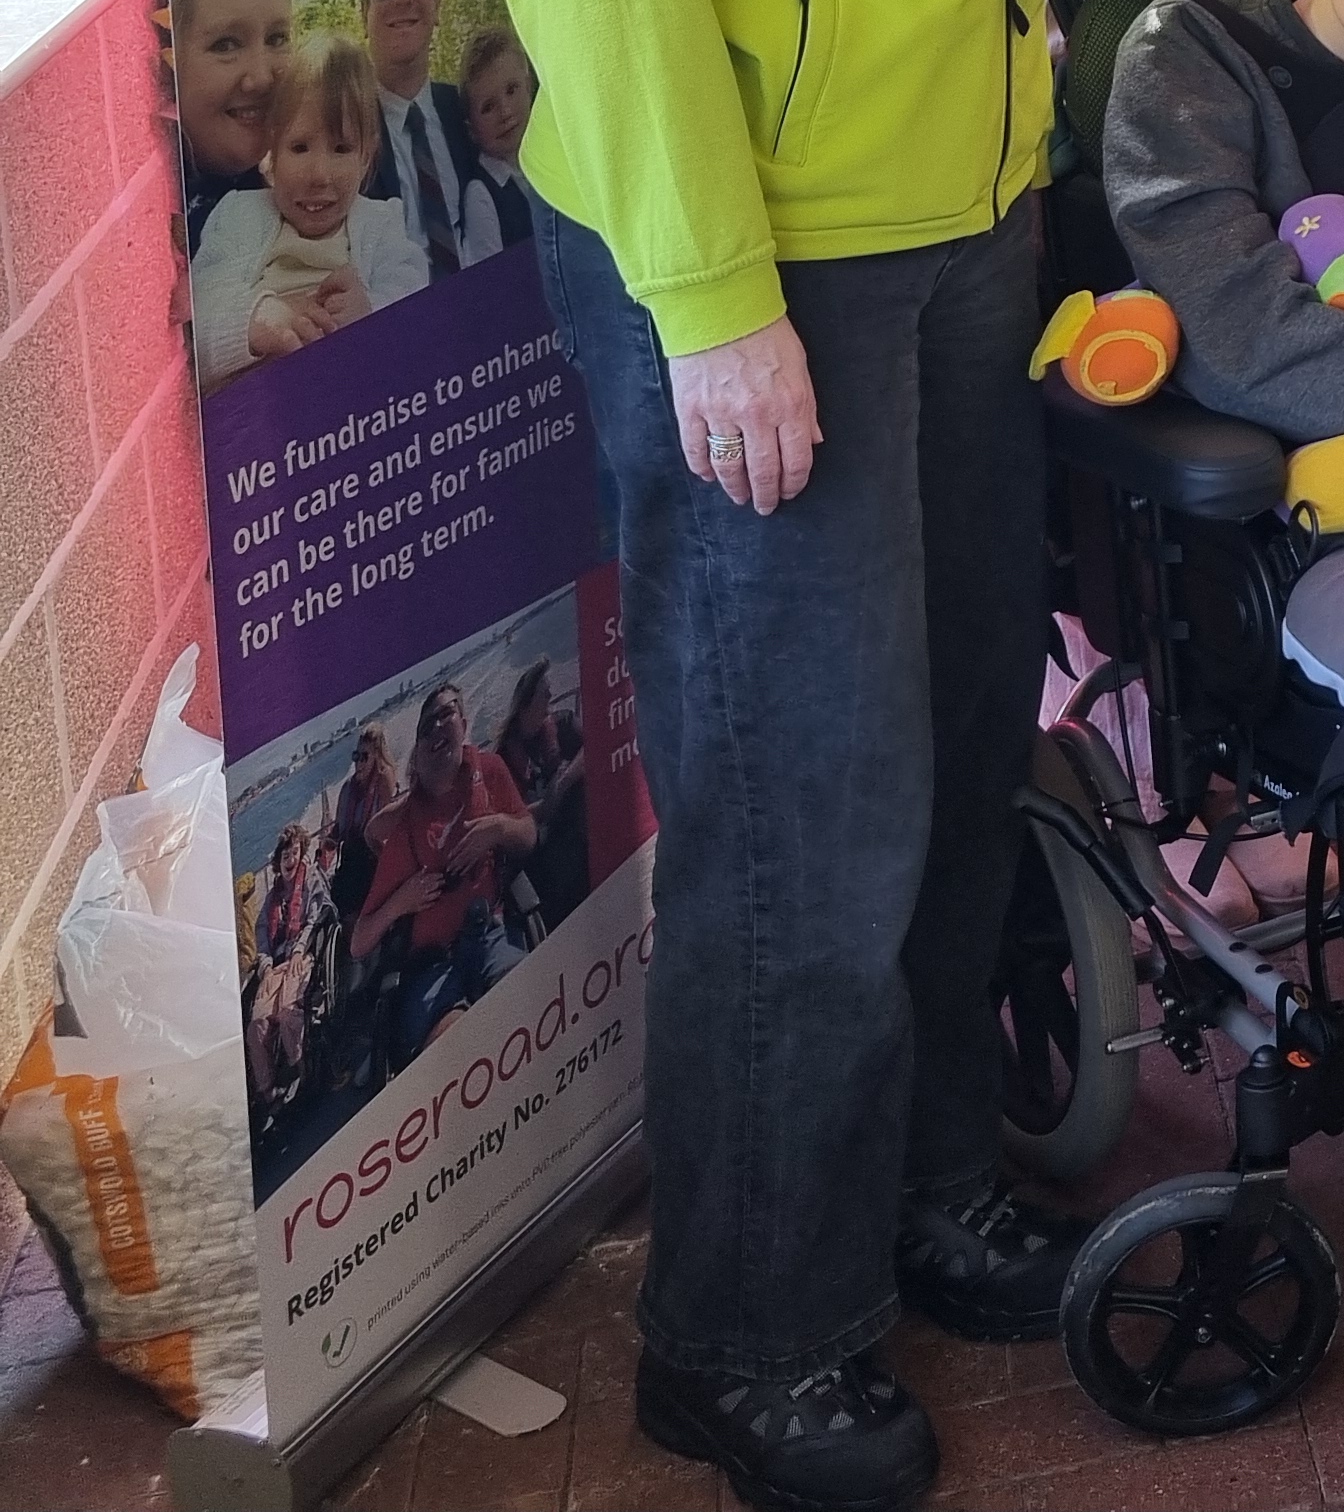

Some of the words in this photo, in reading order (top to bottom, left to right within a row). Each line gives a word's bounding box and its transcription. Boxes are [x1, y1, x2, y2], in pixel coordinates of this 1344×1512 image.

[228, 463, 276, 505] We
[284, 395, 427, 479] fundraise
[434, 372, 464, 405] to
[470, 327, 563, 390] enhanc
[233, 508, 287, 555] our
[293, 474, 359, 524] care
[368, 434, 422, 489] and
[430, 389, 521, 456] ensure
[528, 371, 563, 410] we
[236, 563, 290, 606] can
[299, 538, 335, 574] be
[344, 487, 423, 550] there
[430, 463, 469, 507] for
[477, 411, 576, 482] families
[239, 614, 284, 659] for
[291, 578, 343, 627] the
[352, 541, 413, 598] long
[421, 501, 495, 560] term.
[79, 1110, 113, 1153] BUFF
[281, 914, 656, 1264] roseroad.or
[288, 1190, 418, 1327] Registered
[425, 1117, 508, 1201] Charity
[513, 1095, 551, 1131] No.
[555, 1019, 624, 1096] 276172
[93, 1156, 135, 1250] COTSWOLD
[367, 1288, 403, 1331] printed
[405, 1266, 431, 1294] using
